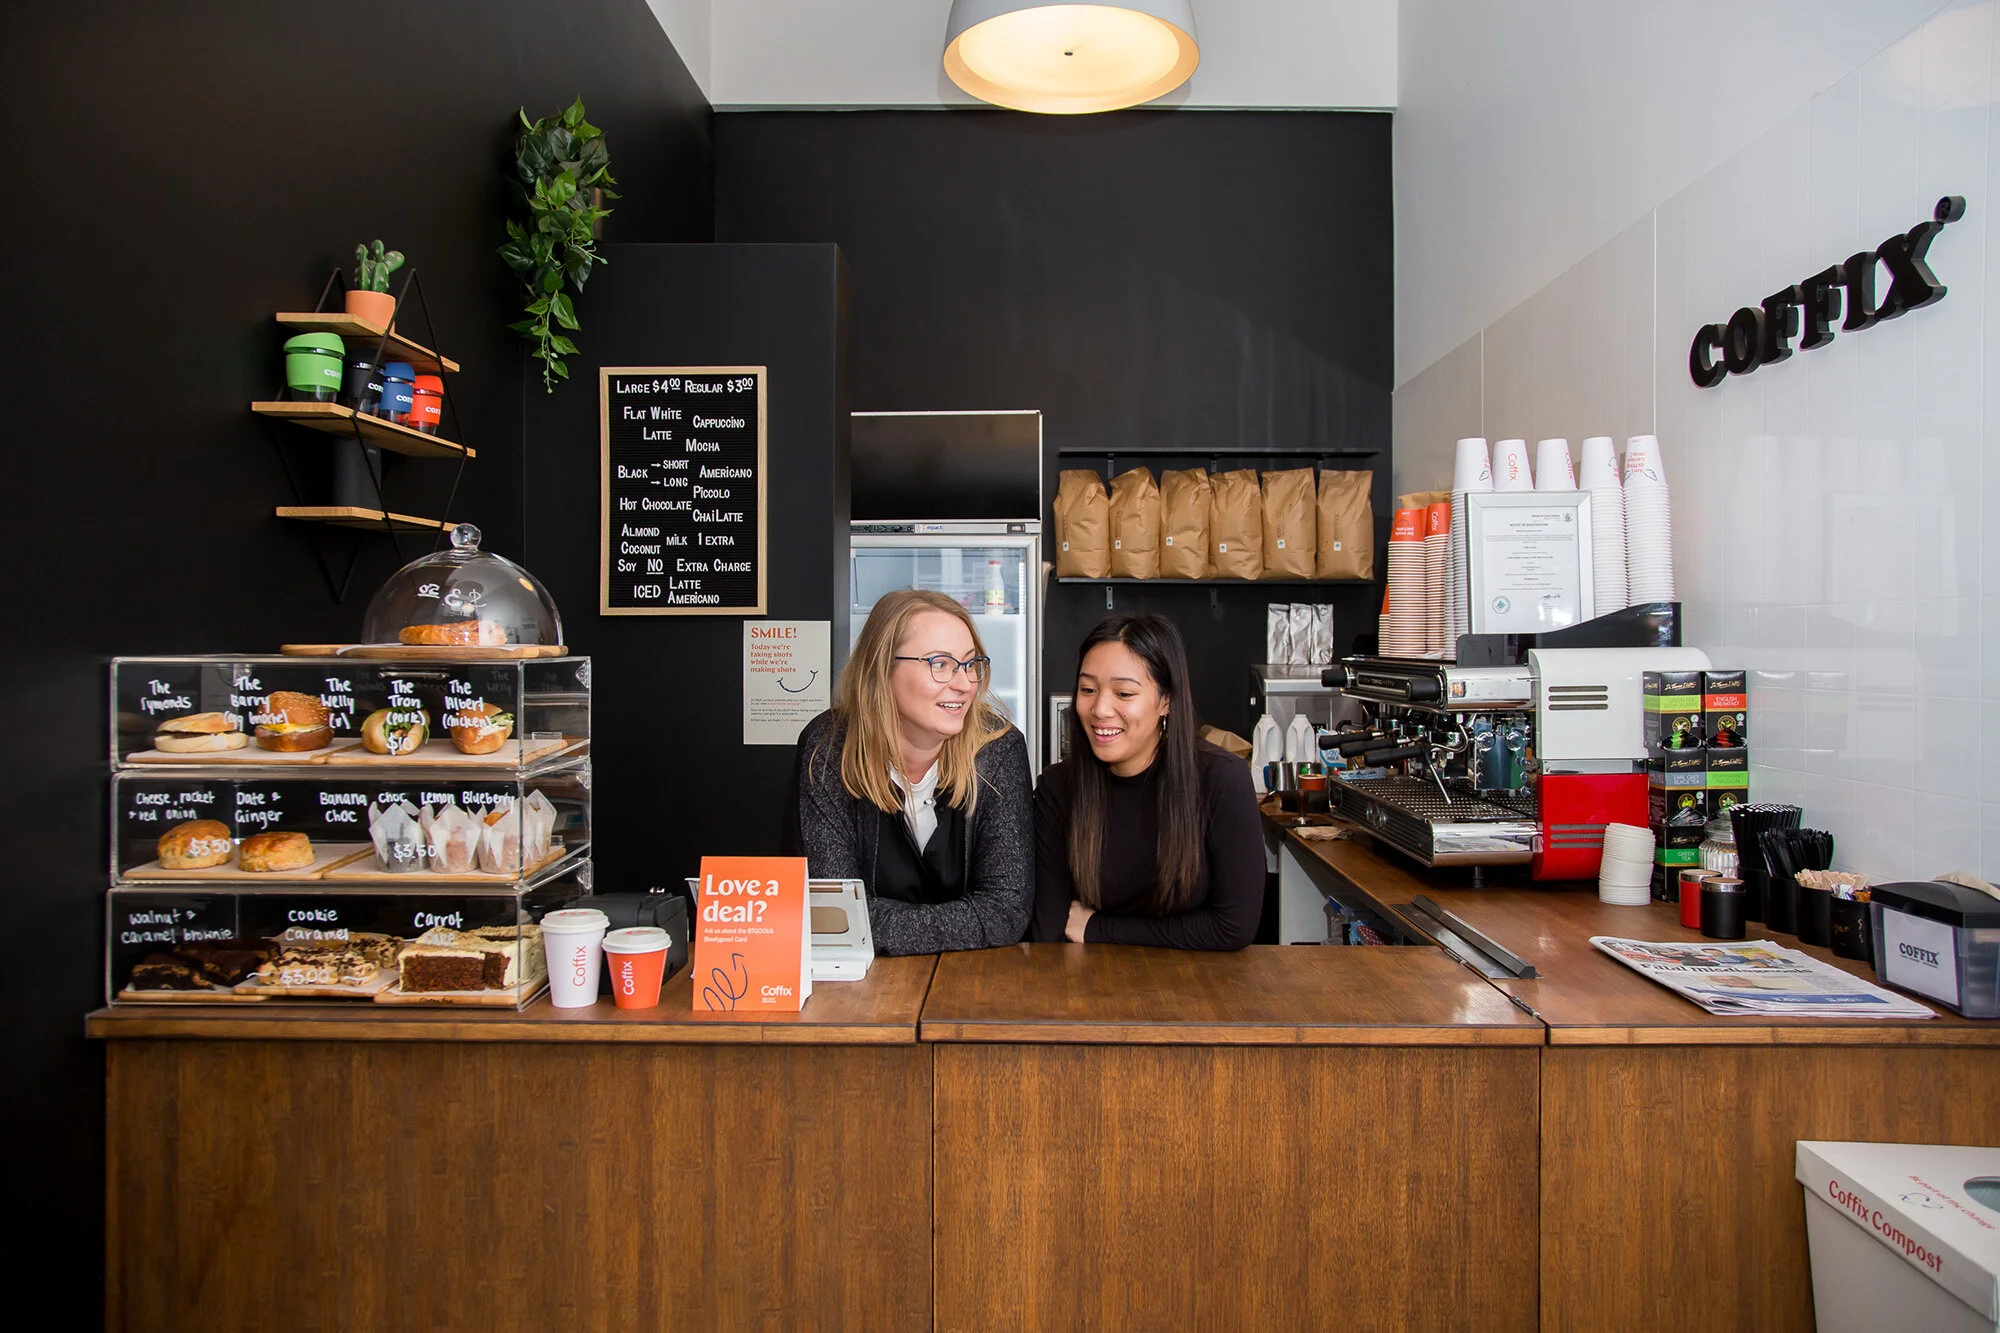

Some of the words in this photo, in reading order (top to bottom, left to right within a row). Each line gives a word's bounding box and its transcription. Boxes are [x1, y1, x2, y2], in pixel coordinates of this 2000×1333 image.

[1690, 219, 1948, 388] COFFIX
[616, 380, 650, 393] LARGE
[684, 380, 723, 393] REGULAR
[623, 406, 646, 420] FLAT
[643, 427, 672, 440] LATTE
[686, 439, 720, 452] MOCHA
[618, 465, 648, 478] BLACK
[662, 460, 689, 469] SHORT
[663, 478, 688, 487] LONG
[620, 497, 638, 510] HOT
[642, 497, 692, 510] CHOCOLATE
[621, 523, 660, 537] ALMOND
[621, 541, 661, 554] COCONUT
[705, 536, 735, 545] EXTRA
[618, 559, 637, 572] SOY
[647, 558, 663, 572] NO
[676, 558, 708, 572] EXTRA
[713, 558, 752, 572] CHARGE
[669, 576, 701, 589] LATTE
[634, 585, 661, 598] ICED
[751, 628, 797, 638] SMILE!
[149, 679, 171, 695] The
[234, 676, 262, 690] The
[325, 678, 352, 692] The
[391, 680, 414, 694] The
[449, 680, 472, 694] The
[388, 695, 421, 708] Tron
[236, 792, 266, 805] Date
[420, 791, 455, 804] Lemon
[190, 837, 231, 857] $3.50
[393, 845, 437, 863] $3.50
[705, 874, 761, 896] Love
[764, 880, 779, 896] a
[703, 900, 768, 923] deal?
[1899, 942, 1939, 965] COFFIX
[573, 946, 586, 986] Coffix
[622, 961, 634, 995] Coffix
[761, 985, 792, 996] Coffix
[1828, 1180, 1869, 1222] Coffix
[1871, 1211, 1943, 1272] Compost
